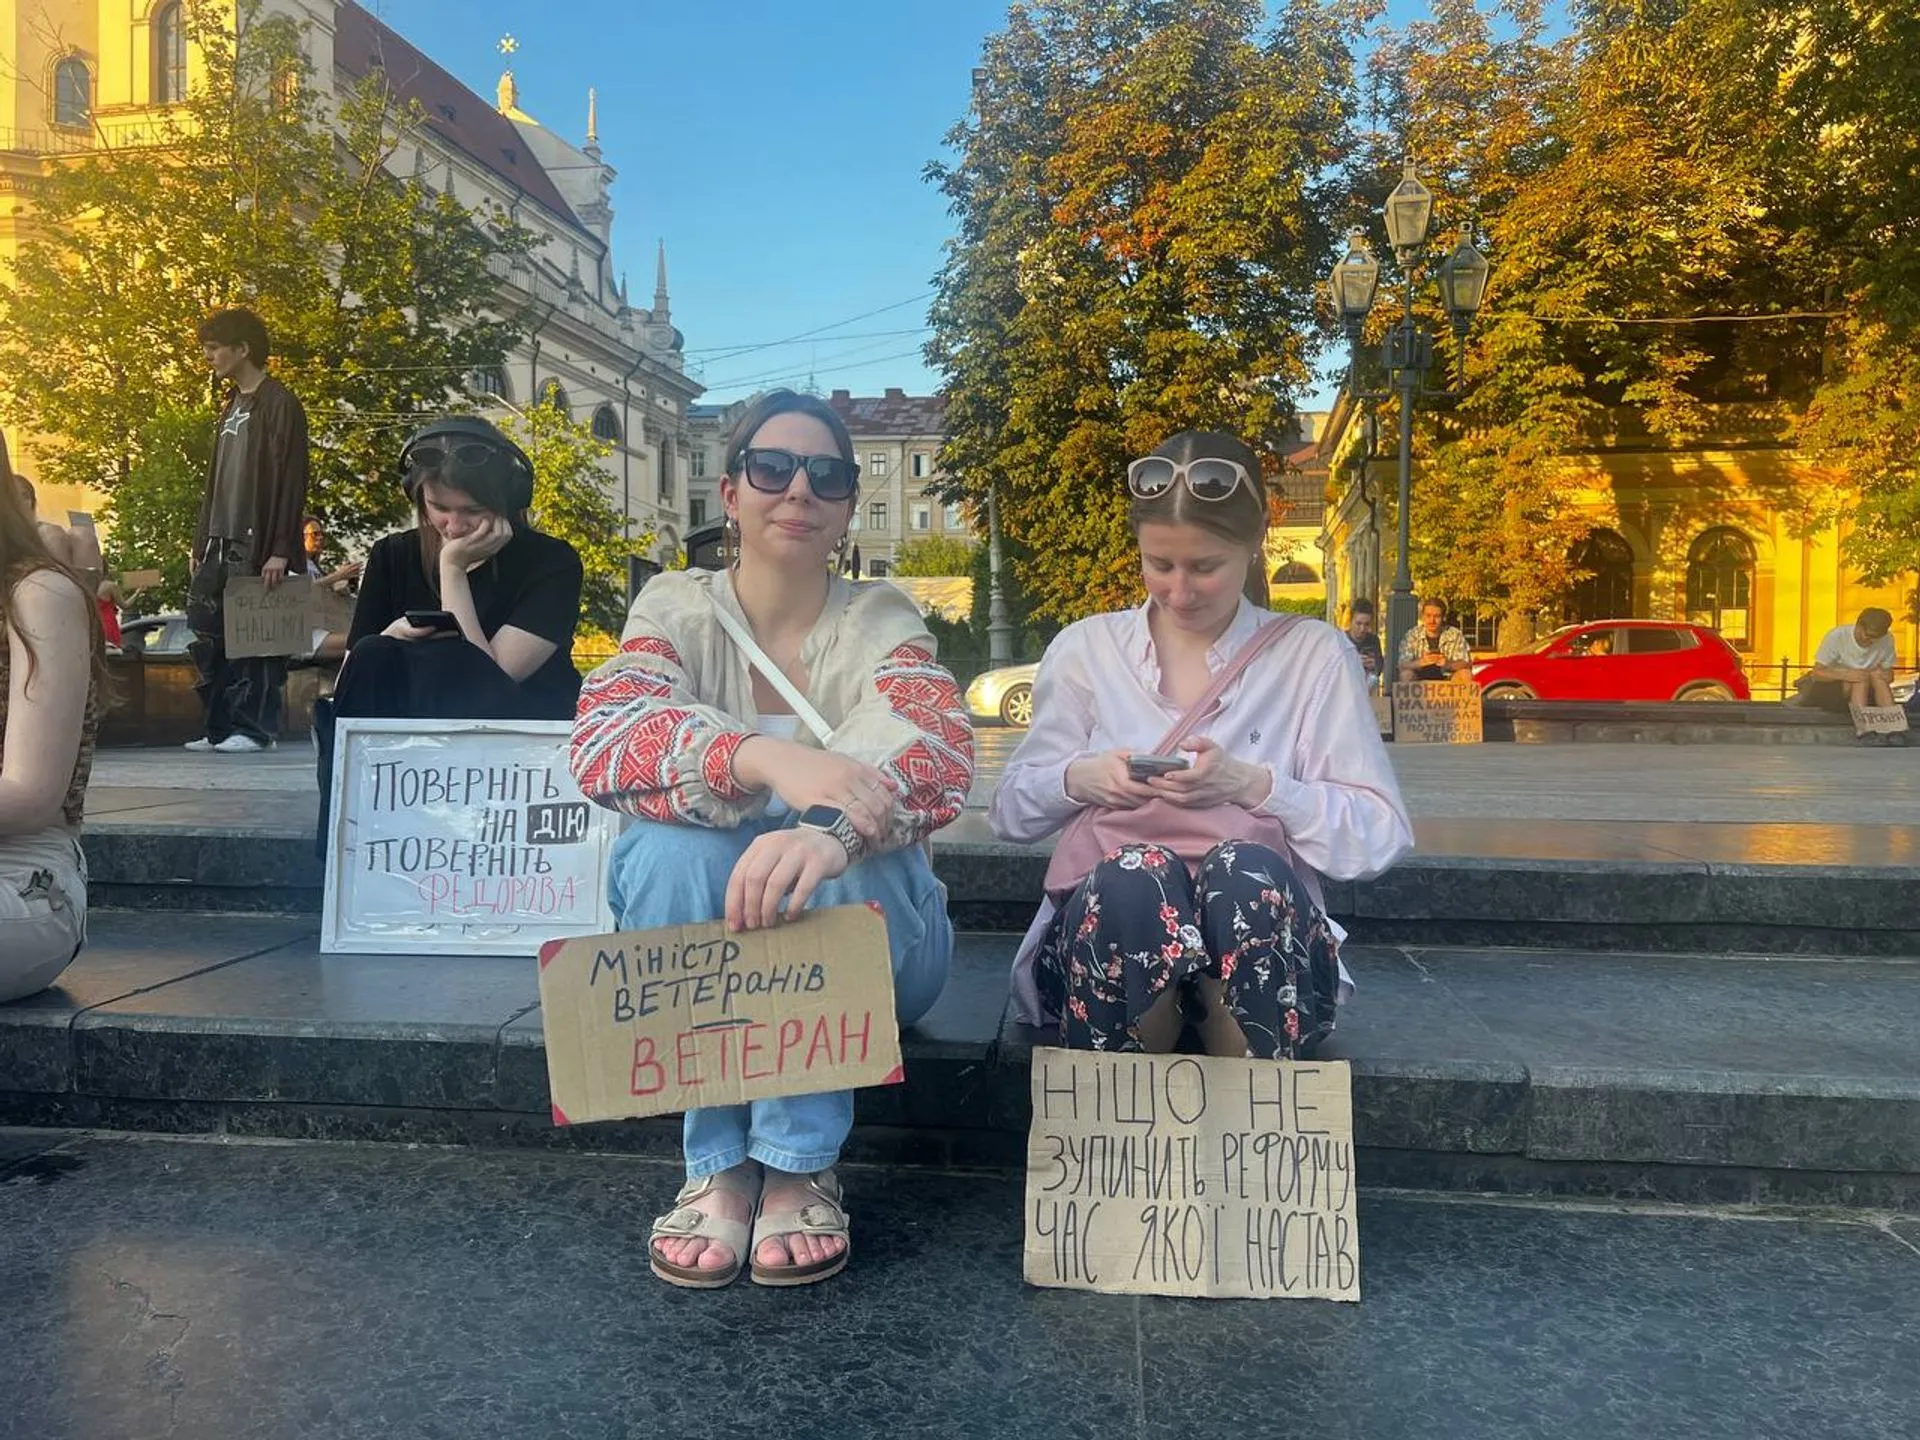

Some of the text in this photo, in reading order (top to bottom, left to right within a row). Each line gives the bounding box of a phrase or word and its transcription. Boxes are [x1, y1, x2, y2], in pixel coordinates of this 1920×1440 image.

[1395, 683, 1480, 699] МОНСТРИ
[480, 805, 588, 844] НА ДІЮ
[364, 837, 553, 877] ПОВЕРНІТЬ
[418, 873, 577, 914] ФЕДОРОВА
[630, 1010, 872, 1096] ВЕТЕРАН
[1043, 1058, 1330, 1136] НІЩО НЕ
[1042, 1132, 1351, 1212] ЗУПИНИТЬ РЕФОРМУ
[1036, 1198, 1355, 1291] ЧАС ЯКОЇ НАСТАВ
